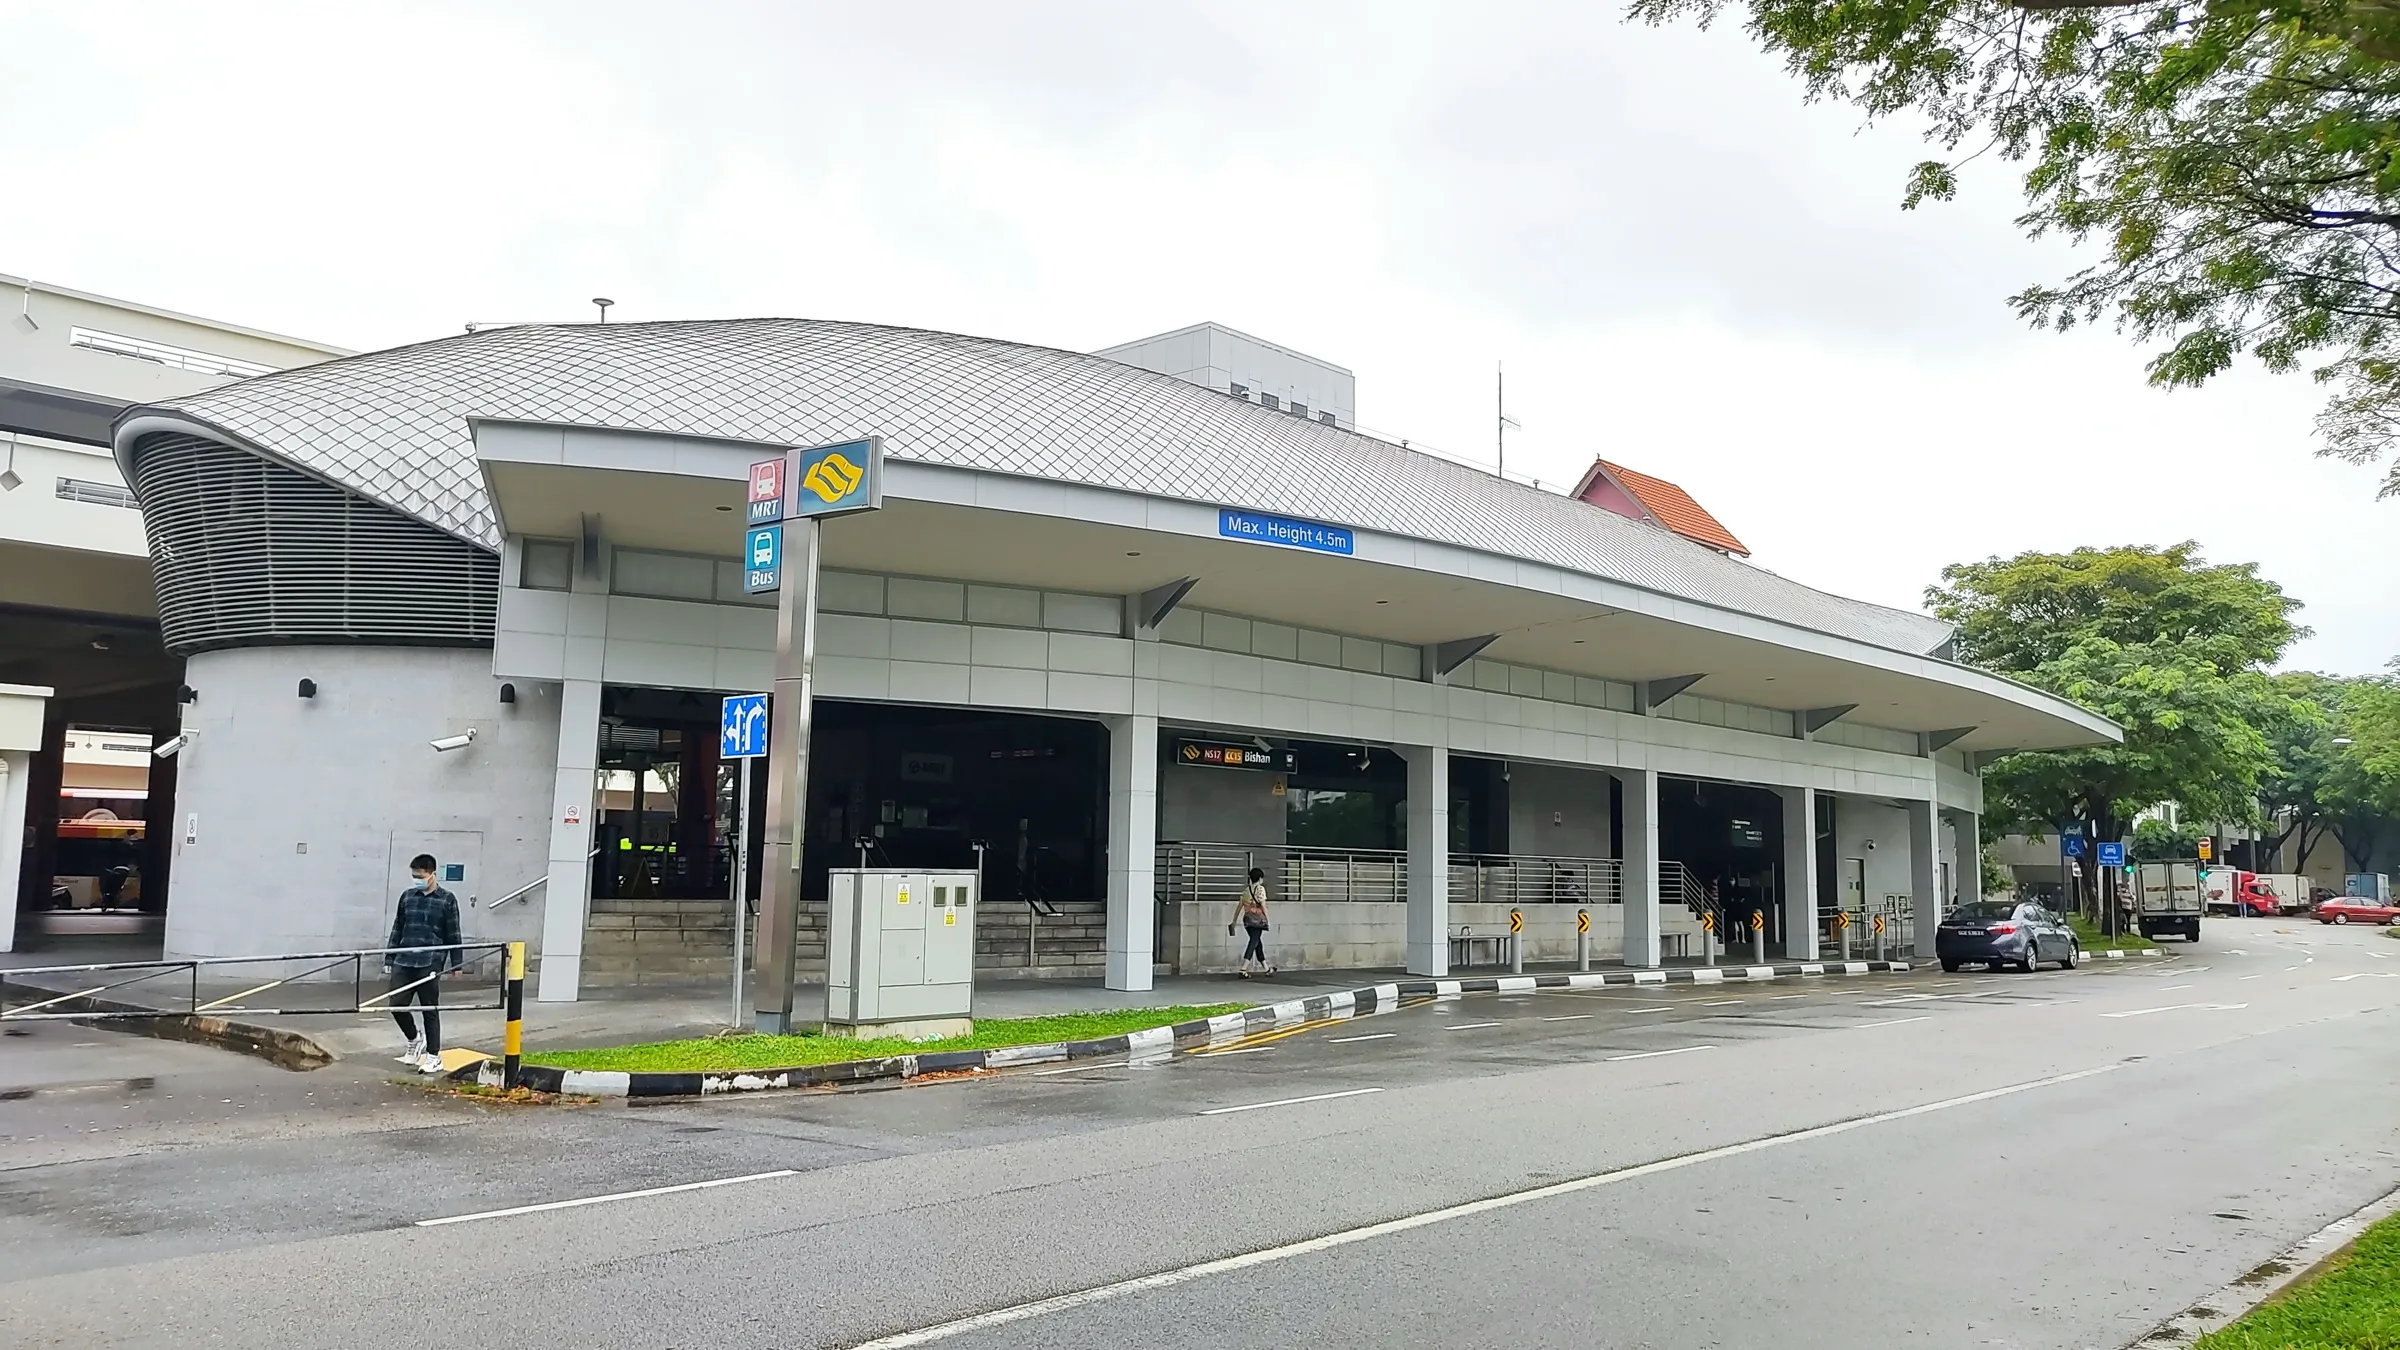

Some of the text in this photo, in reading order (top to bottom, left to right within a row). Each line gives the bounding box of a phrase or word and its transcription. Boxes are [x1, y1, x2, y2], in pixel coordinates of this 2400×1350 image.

[752, 500, 778, 519] MRT
[1228, 516, 1346, 549] Max. Height 4.5m
[751, 571, 774, 586] Bus
[1204, 749, 1271, 763] NS17 CC15 Bishan
